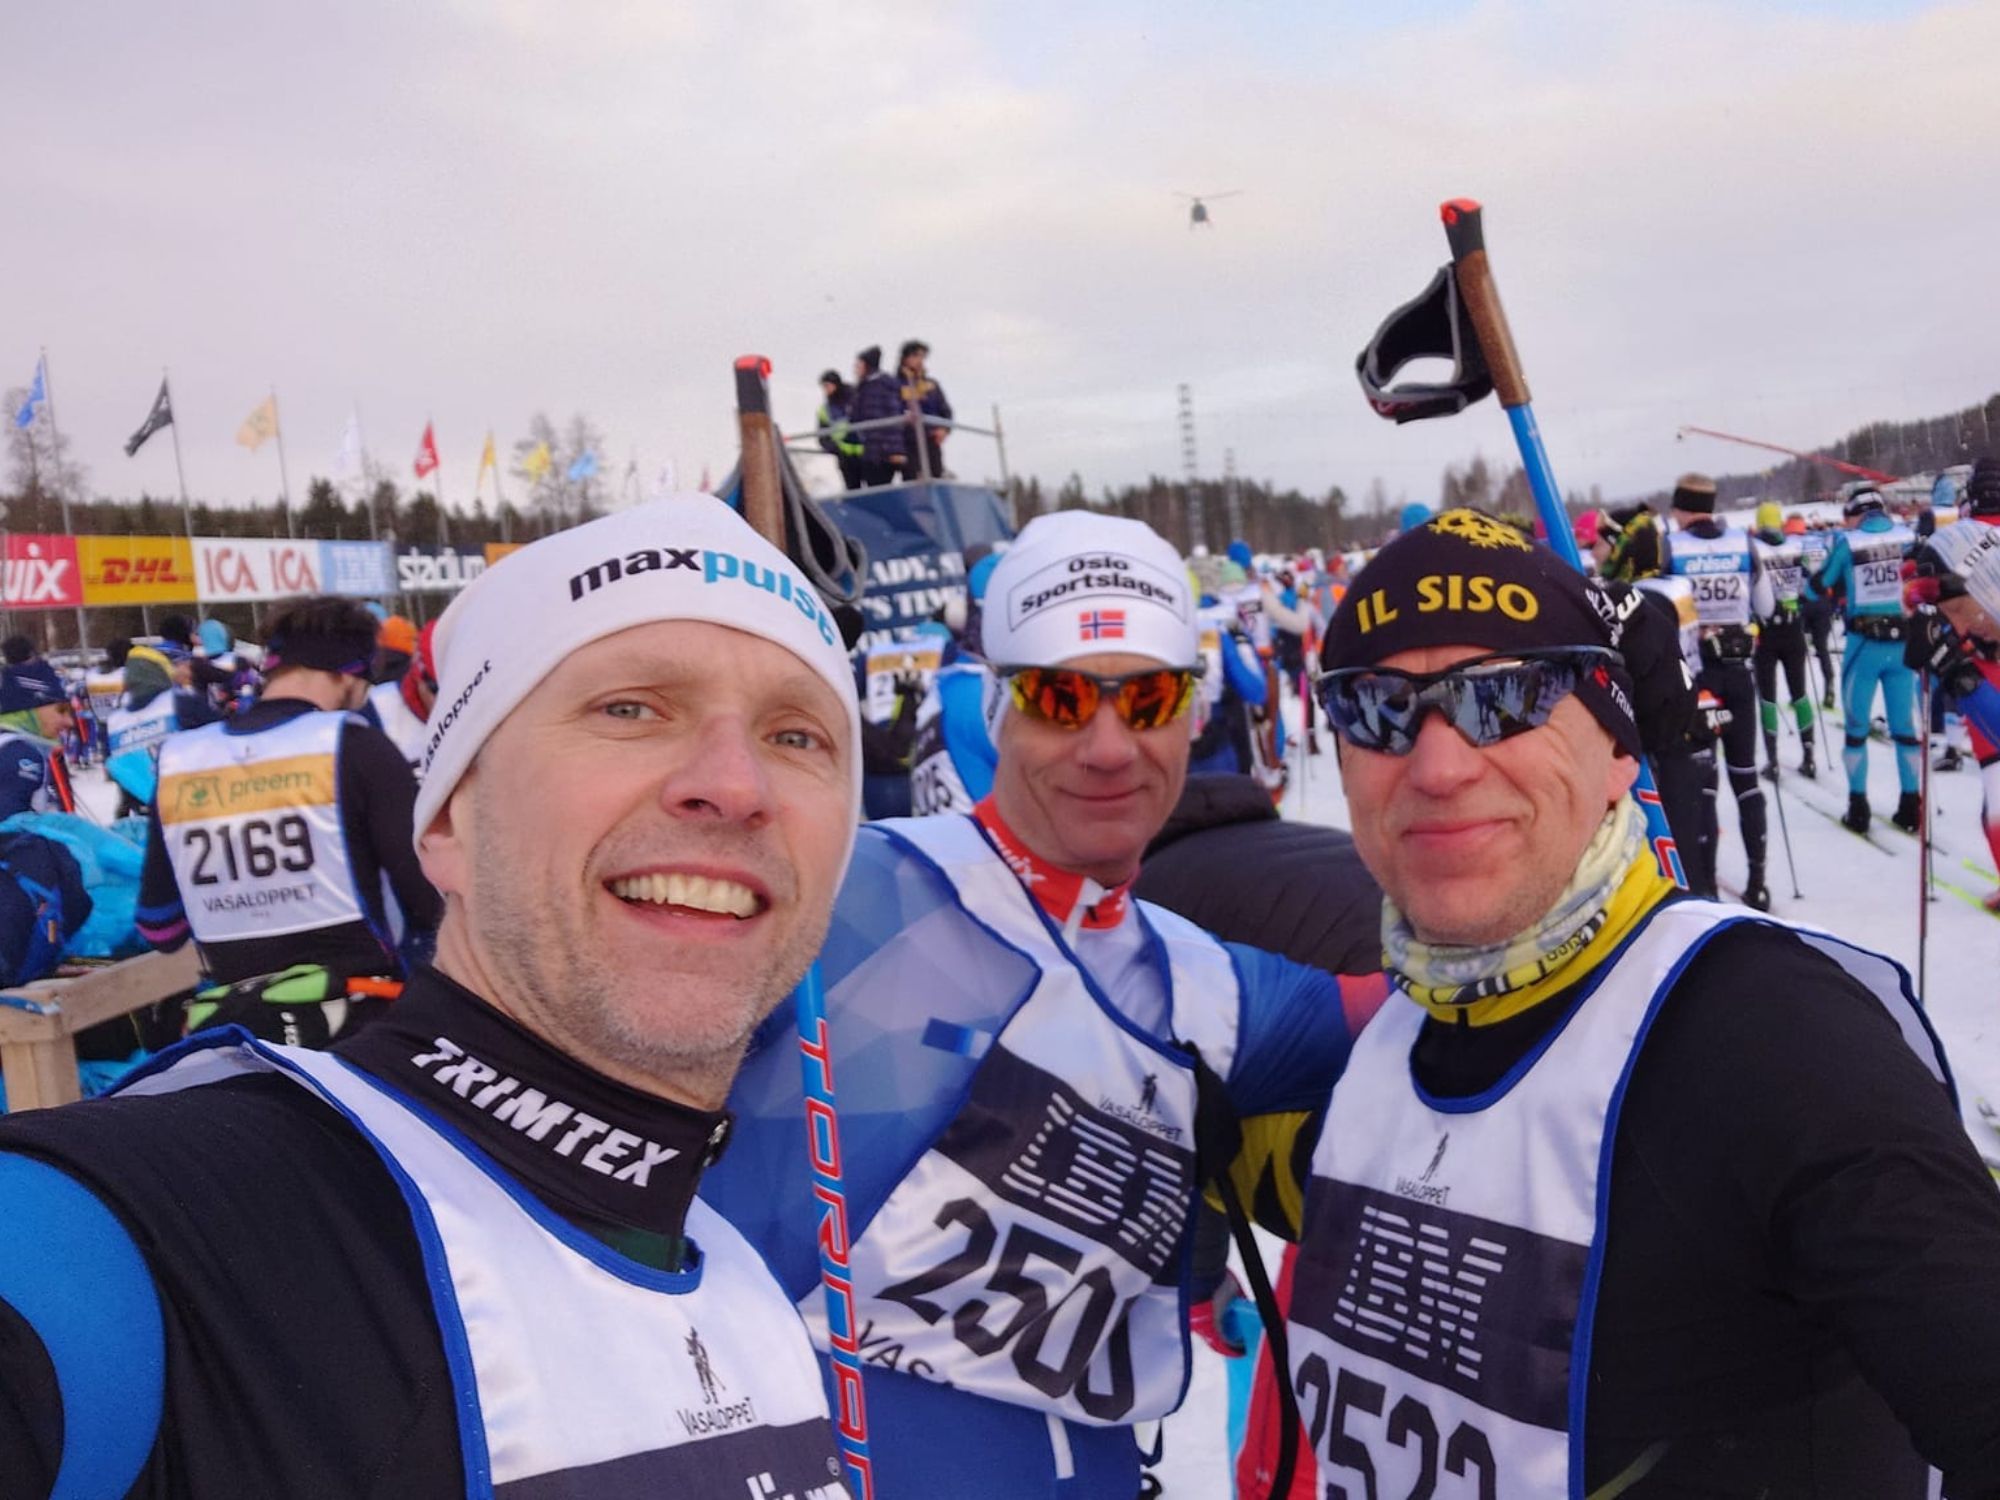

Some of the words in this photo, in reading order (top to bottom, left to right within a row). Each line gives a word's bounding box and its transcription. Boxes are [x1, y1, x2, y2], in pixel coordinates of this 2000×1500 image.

[102, 558, 180, 585] DHL
[206, 548, 257, 594] ICA
[269, 547, 321, 593] ICA
[1068, 556, 1130, 574] Oslo
[1020, 572, 1175, 614] Sportslager
[1356, 589, 1398, 634] IL
[1416, 574, 1539, 622] SISO
[229, 770, 313, 801] preem
[183, 814, 315, 886] 2169
[202, 883, 316, 912] VASALOPPET
[410, 1037, 680, 1188] TRIMTEX
[1333, 1205, 1507, 1380] IBM
[676, 1396, 758, 1437] VASALOPPET
